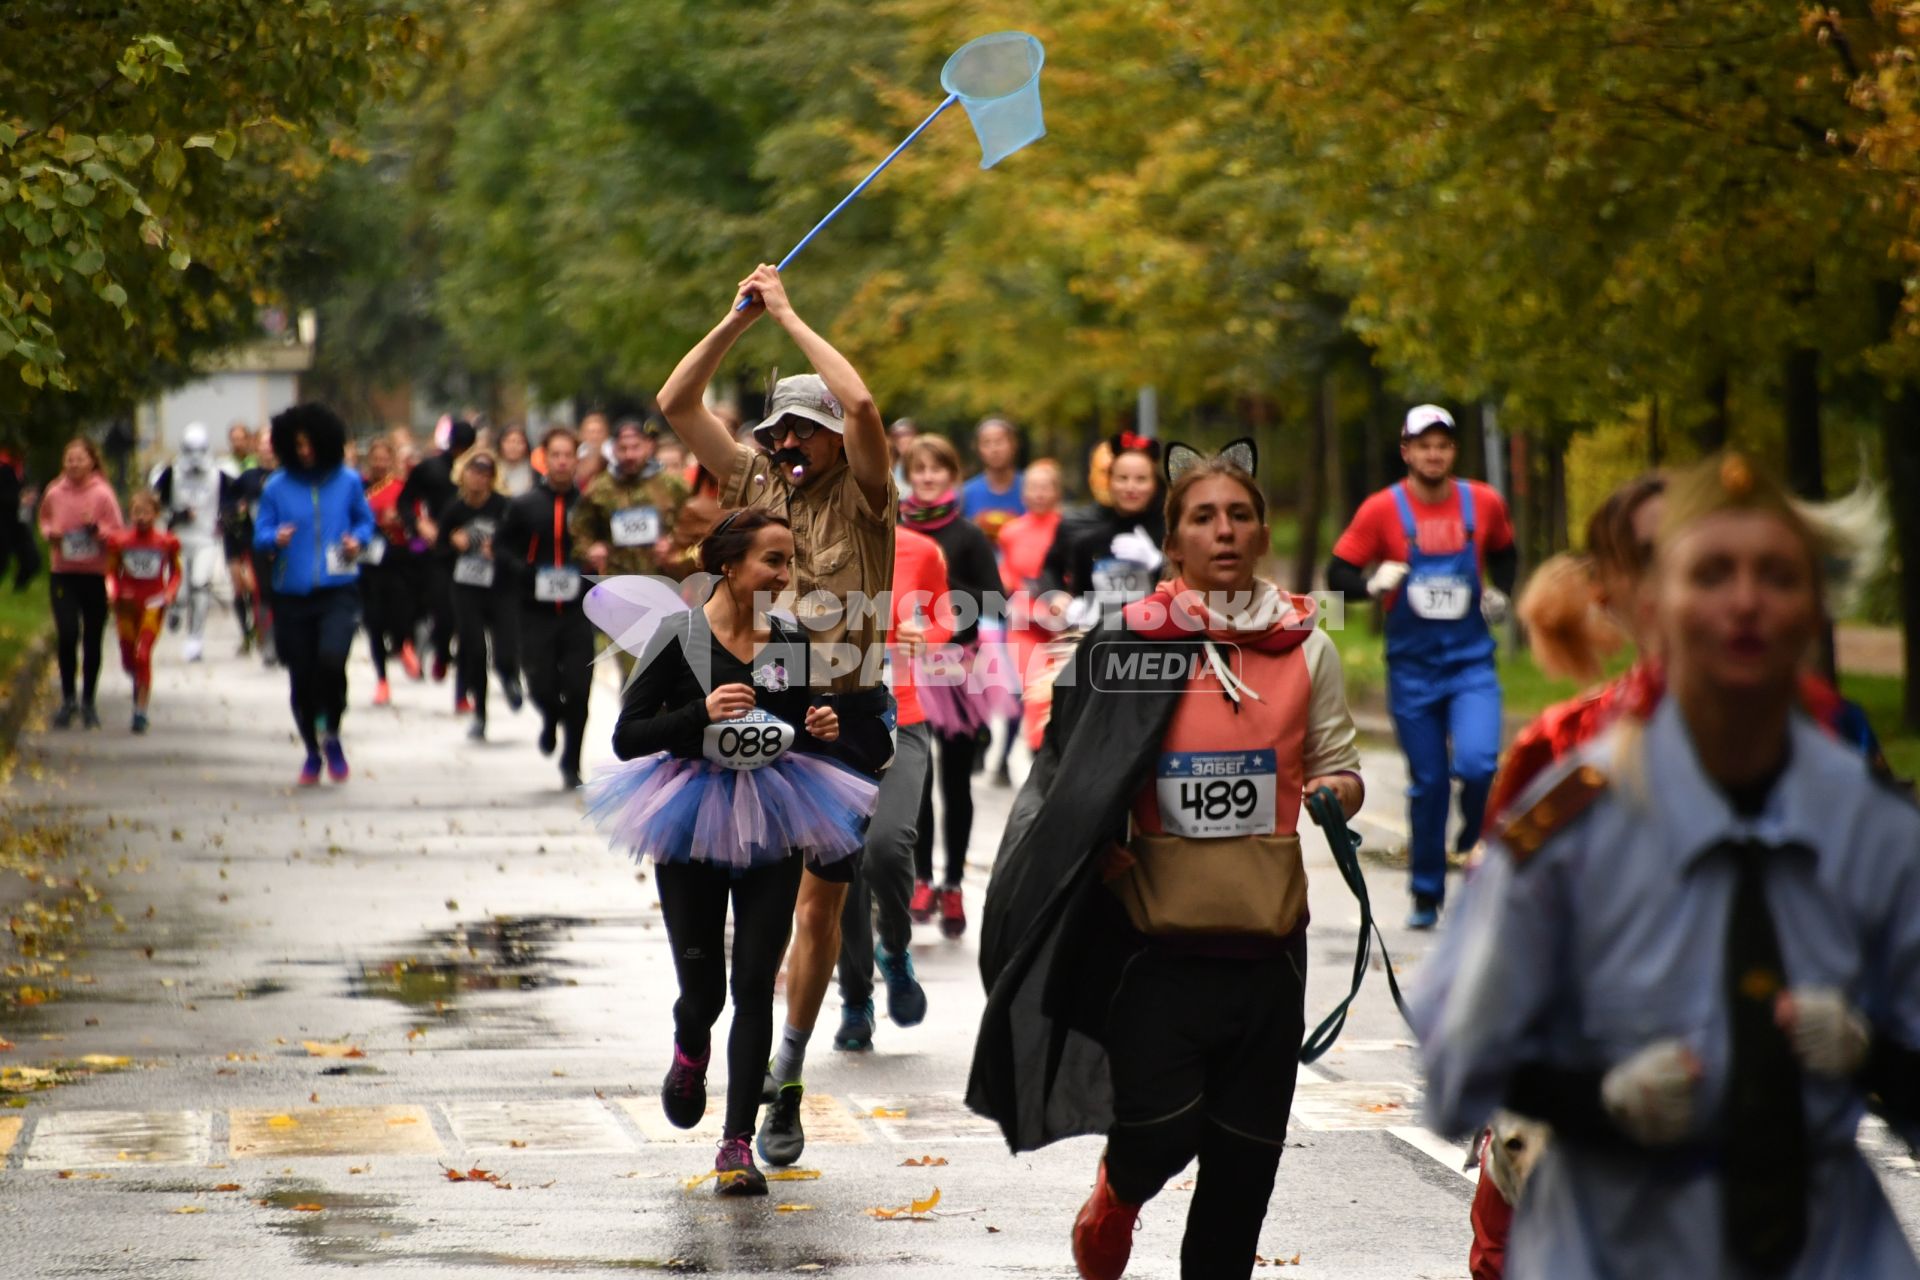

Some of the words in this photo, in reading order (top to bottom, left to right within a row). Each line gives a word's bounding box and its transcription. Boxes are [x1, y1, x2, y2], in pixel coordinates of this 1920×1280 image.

[718, 726, 782, 758] 088
[1191, 762, 1245, 776] ЗАБЕГ
[1181, 779, 1258, 820] 489
